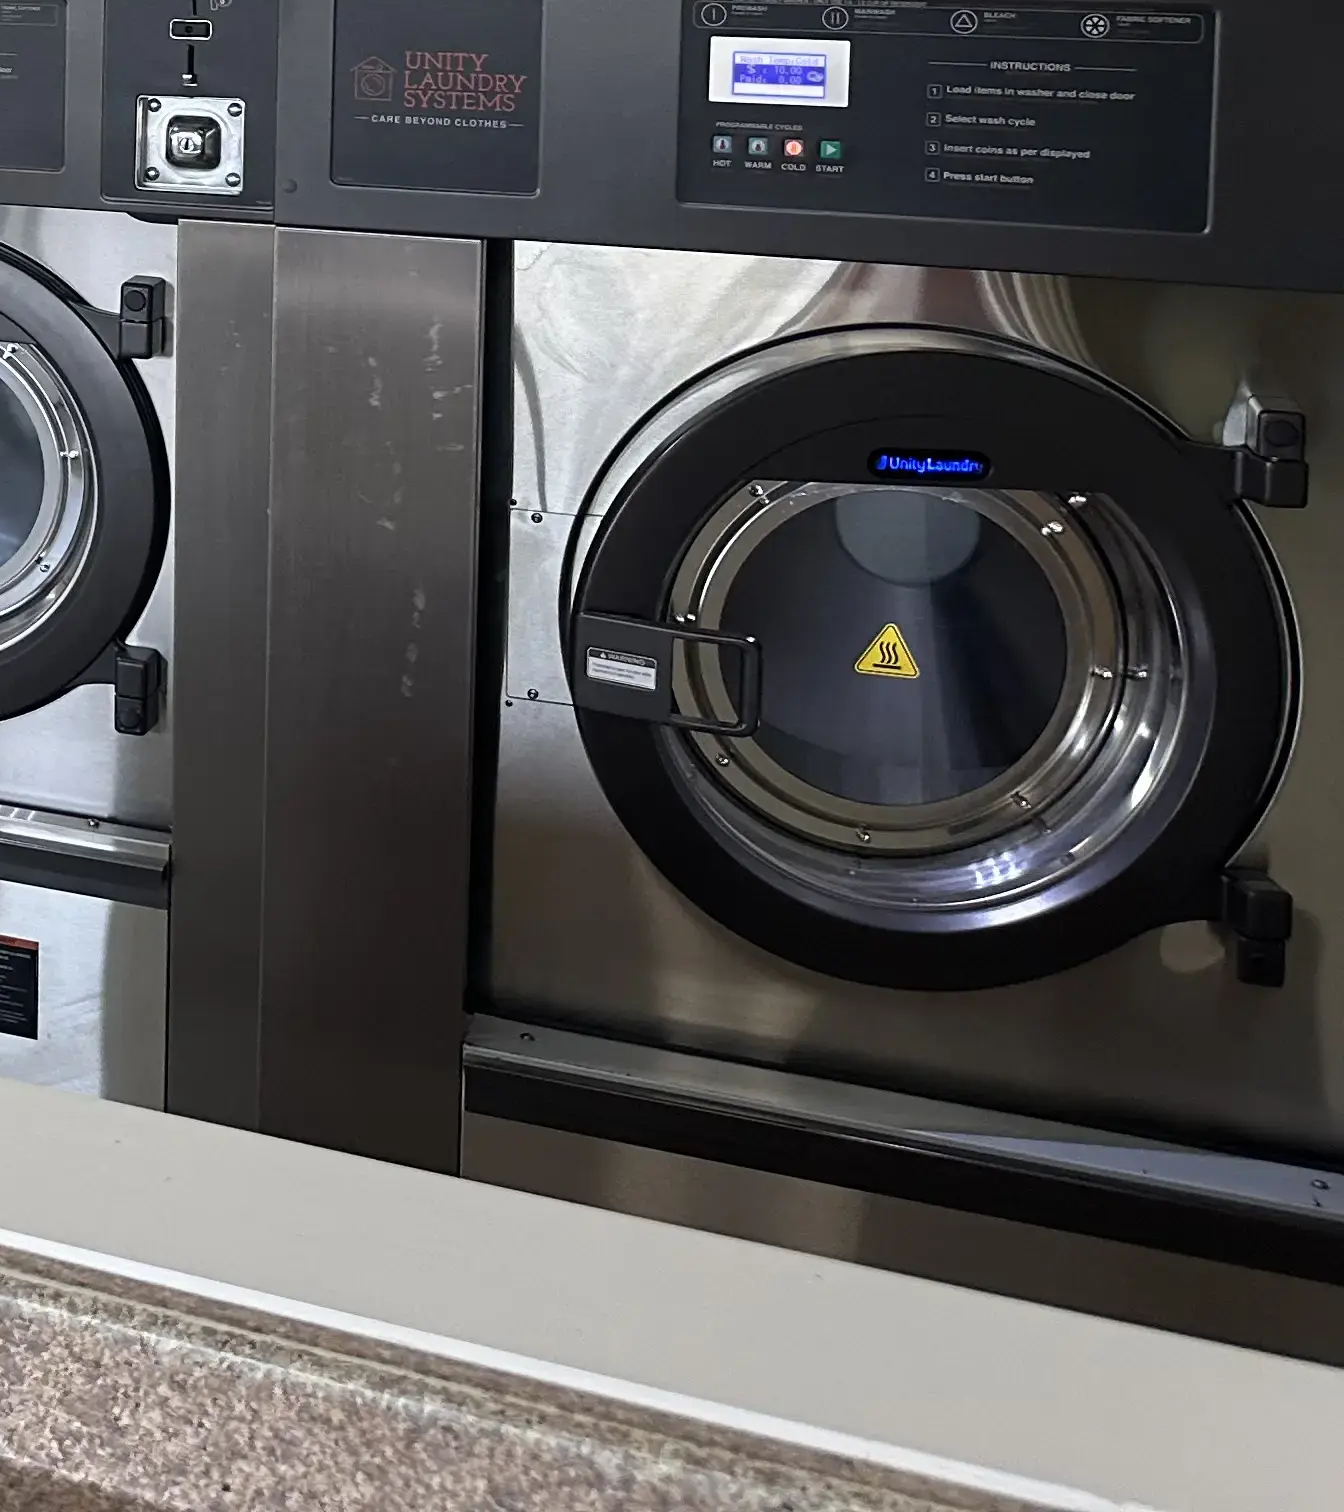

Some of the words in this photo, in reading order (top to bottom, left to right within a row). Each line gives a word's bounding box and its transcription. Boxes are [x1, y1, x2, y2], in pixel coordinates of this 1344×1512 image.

[404, 50, 489, 72] UNITY
[990, 61, 1072, 72] INSTRUCTIONS
[774, 66, 803, 75] 10.00
[404, 70, 529, 93] LAUNDRY
[946, 85, 972, 94] Load
[973, 85, 1002, 96] items
[1004, 87, 1015, 96] in
[1017, 87, 1054, 98] washer
[1056, 88, 1077, 99] and
[1078, 90, 1108, 100] close
[1109, 91, 1136, 101] door
[403, 90, 516, 113] SYSTEMS
[371, 114, 400, 124] CARE
[405, 116, 451, 126] BEYOND
[454, 118, 507, 129] CLOTHES
[774, 123, 803, 131] CYCLES
[945, 113, 977, 124] Select
[978, 115, 1006, 125] wash
[1007, 116, 1036, 128] cycle
[943, 143, 974, 153] Insert
[975, 145, 1004, 156] coins
[1005, 148, 1018, 156] as
[1020, 148, 1038, 158] per
[1039, 149, 1091, 160] displayed
[712, 159, 733, 167] HOT
[744, 160, 773, 169] WARM
[781, 162, 807, 172] COLD
[815, 164, 845, 173] START
[943, 171, 972, 181] Press
[974, 173, 998, 183] start
[1000, 175, 1035, 185] button
